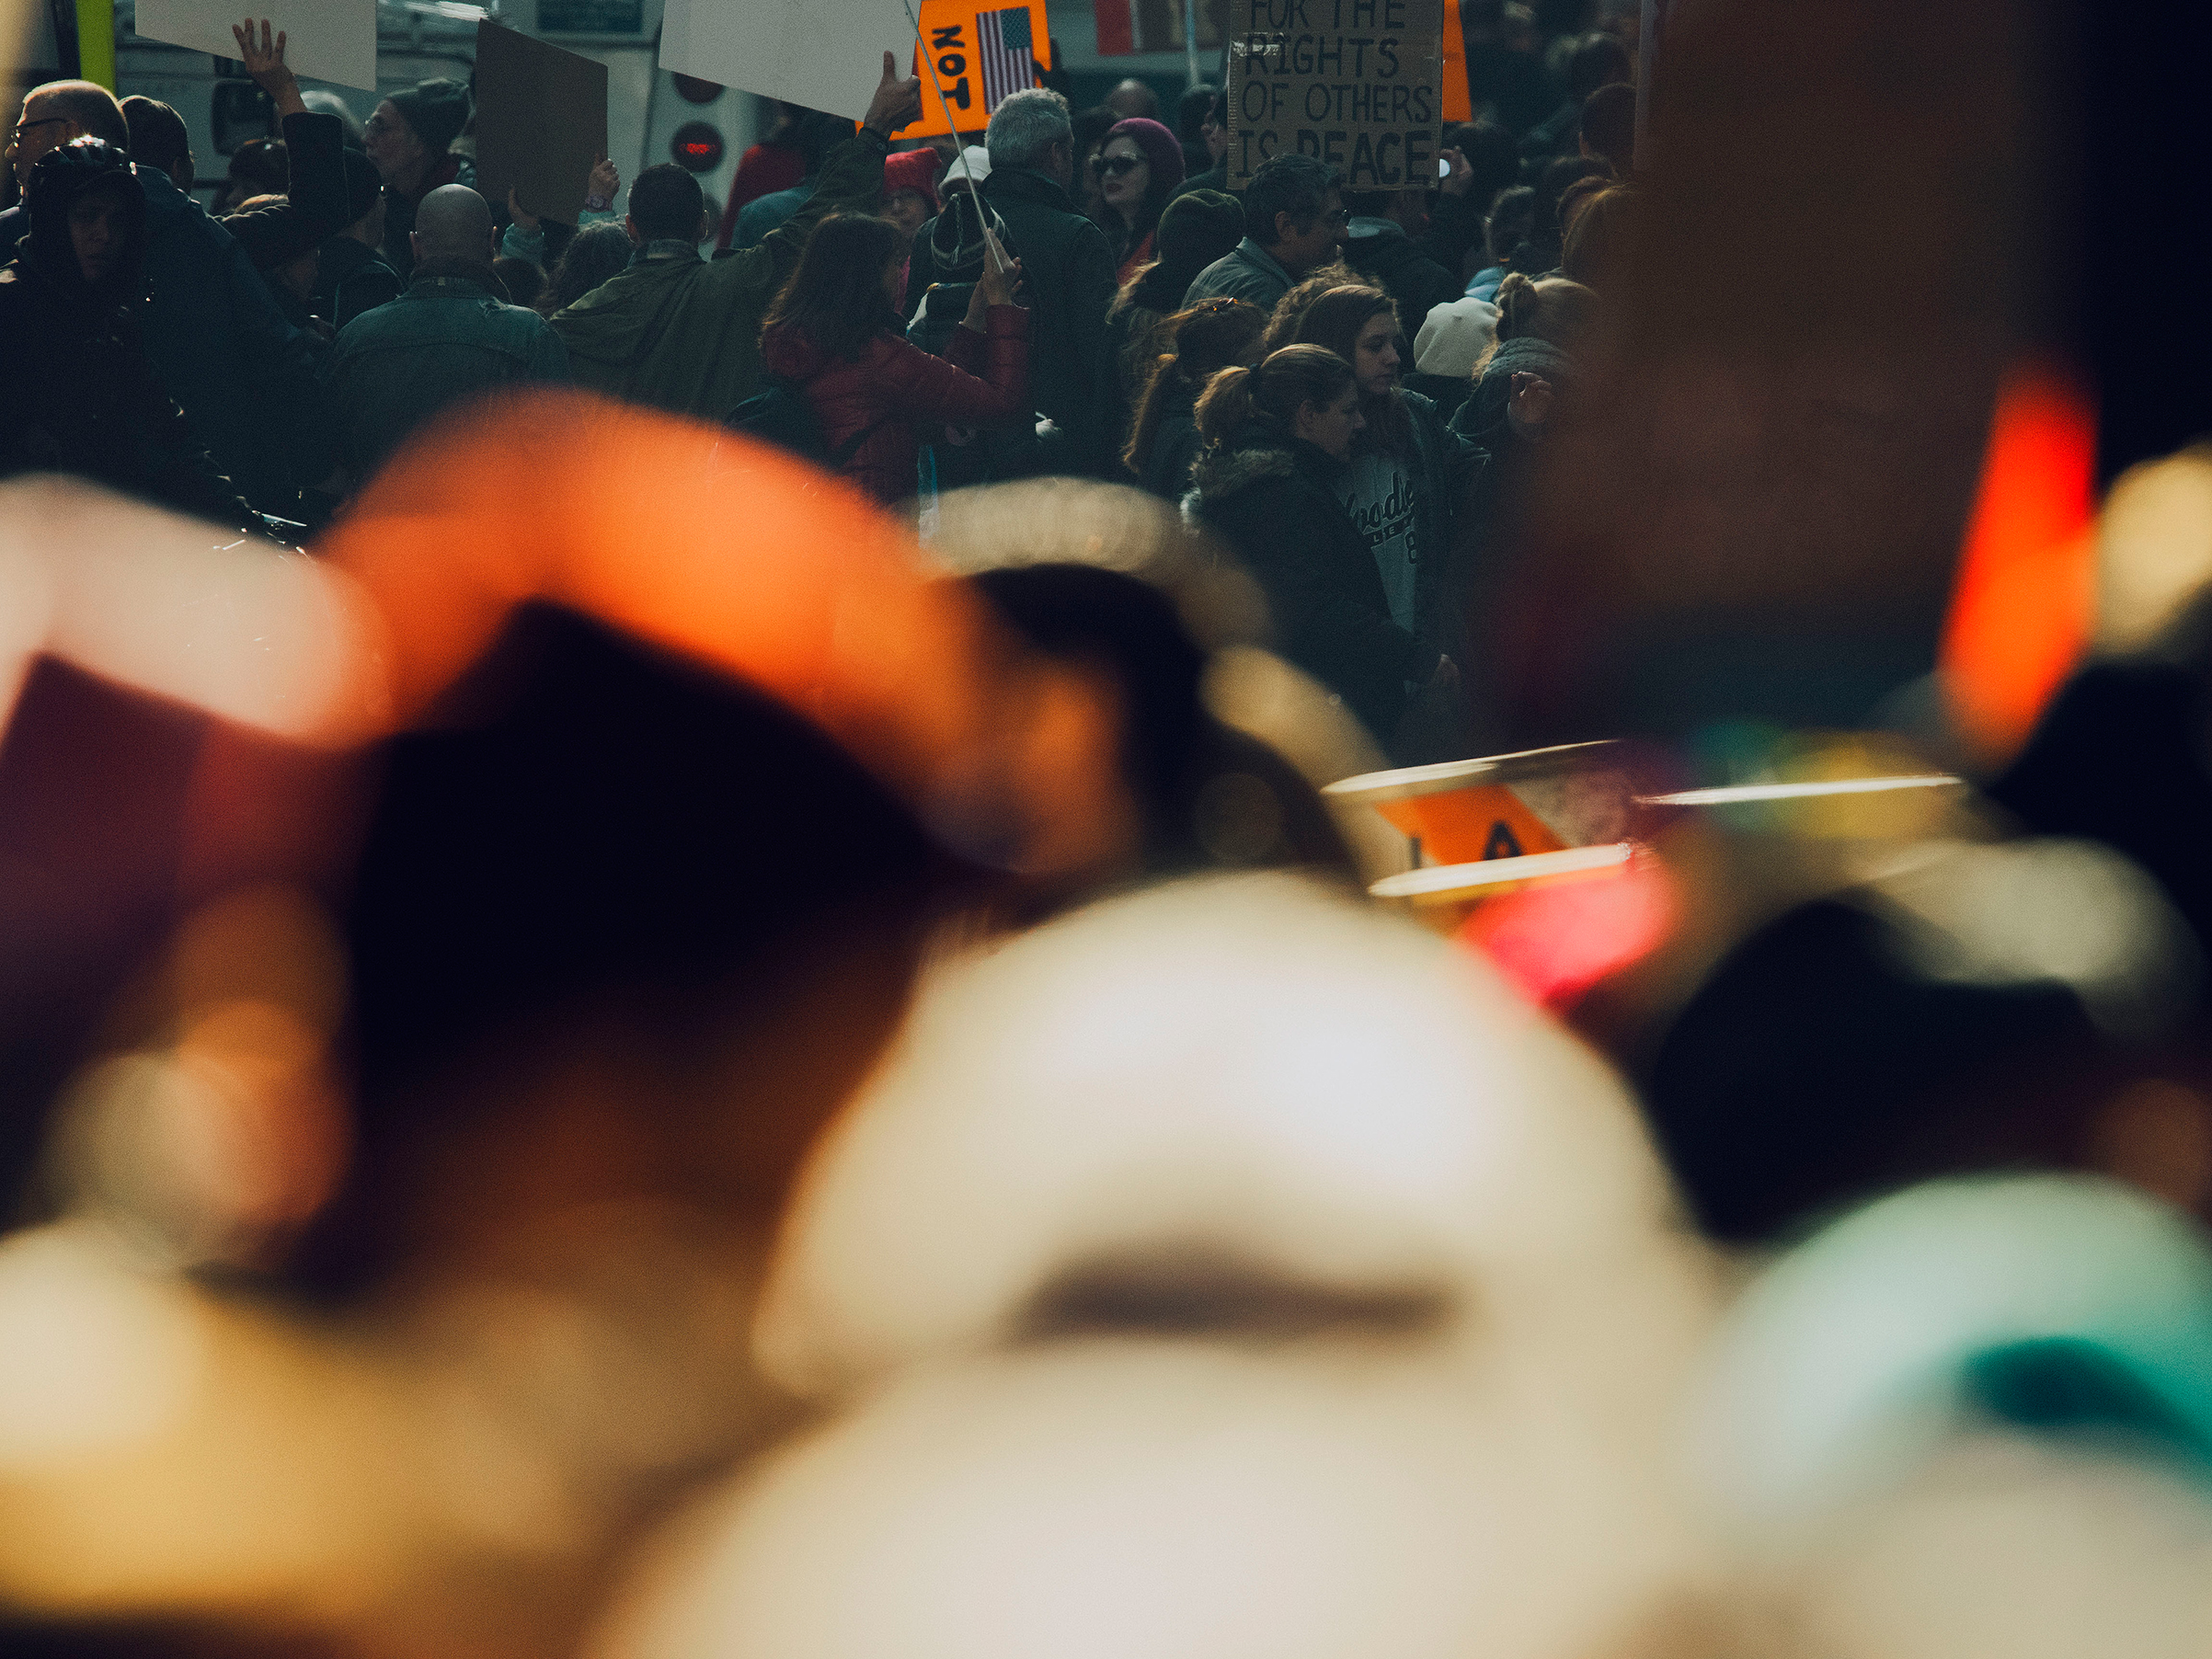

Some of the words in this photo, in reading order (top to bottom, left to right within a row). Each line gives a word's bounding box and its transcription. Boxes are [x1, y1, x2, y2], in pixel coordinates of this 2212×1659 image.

[1251, 0, 1310, 29] FOR
[932, 25, 970, 110] NOT
[1244, 34, 1400, 79] RIGHTS
[1242, 80, 1289, 122] OF
[1305, 83, 1432, 123] OTHERS
